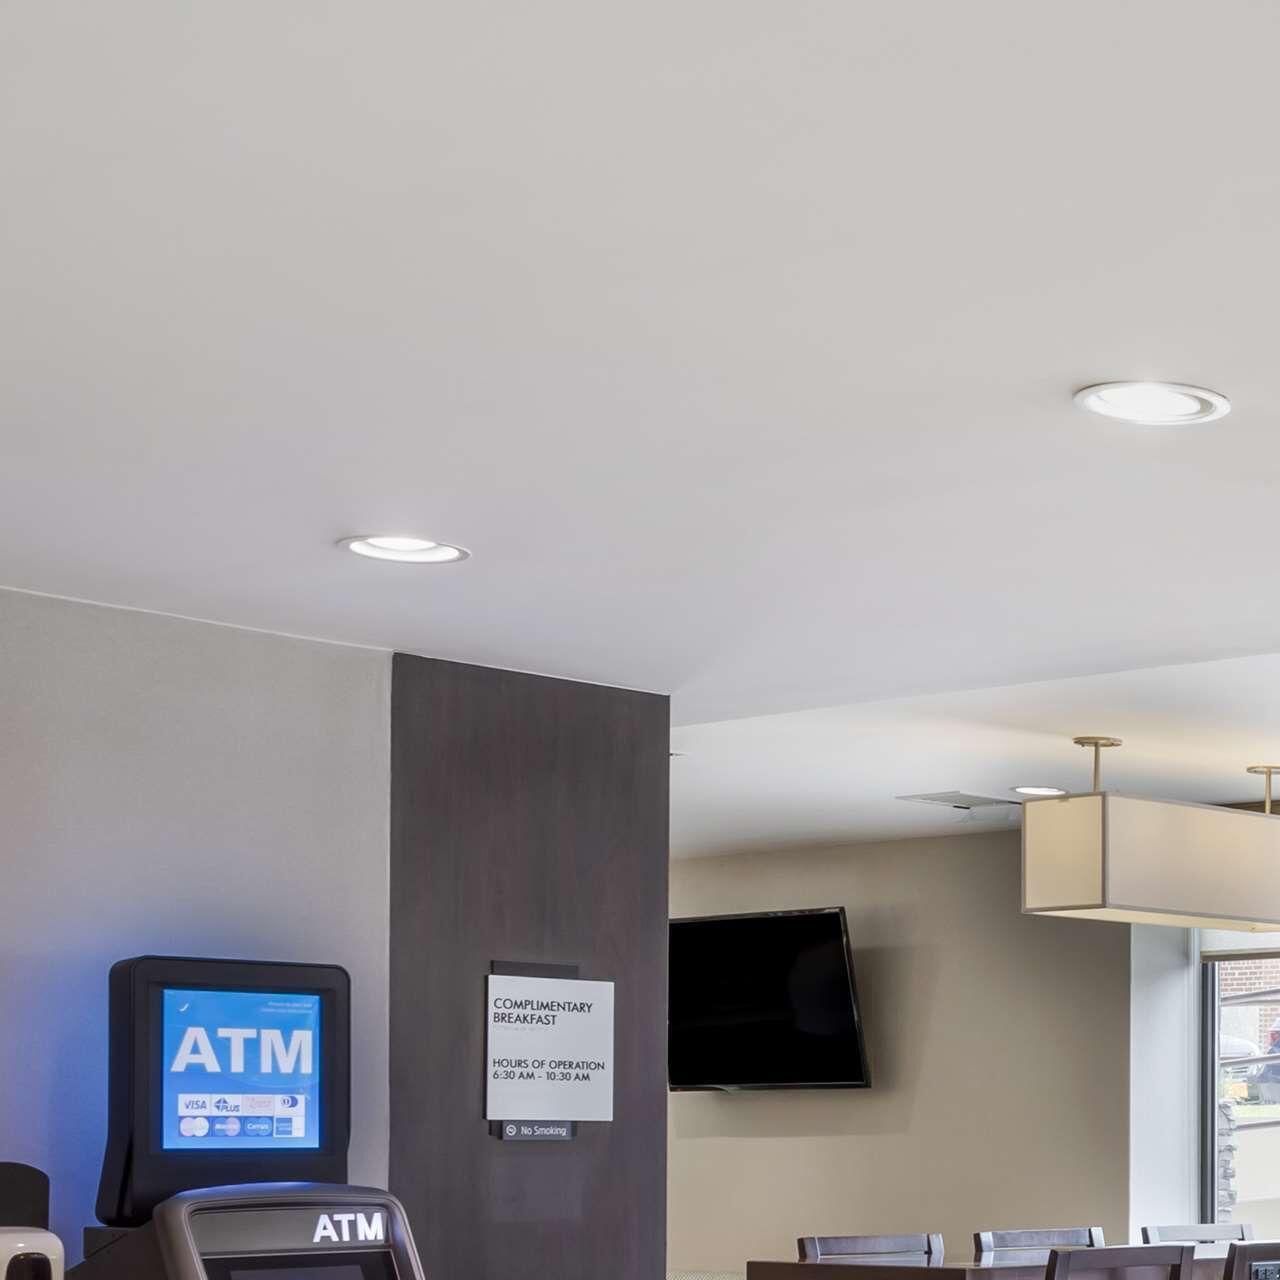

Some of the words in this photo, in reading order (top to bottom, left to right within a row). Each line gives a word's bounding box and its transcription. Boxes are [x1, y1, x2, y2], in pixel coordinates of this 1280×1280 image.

[493, 998, 592, 1013] COMPLIMENTARY
[493, 1012, 557, 1025] BREAKFAST
[170, 1027, 313, 1074] ATM
[493, 1058, 529, 1068] HOURS
[532, 1059, 546, 1069] OF
[549, 1060, 605, 1070] OPERATION
[493, 1071, 515, 1080] 6:30
[518, 1072, 535, 1080] AM
[546, 1072, 571, 1081] 10:30
[573, 1072, 591, 1081] AM
[184, 1100, 207, 1110] VISA
[521, 1126, 533, 1135] No
[534, 1126, 567, 1137] Smoking
[312, 1213, 384, 1243] ATM
